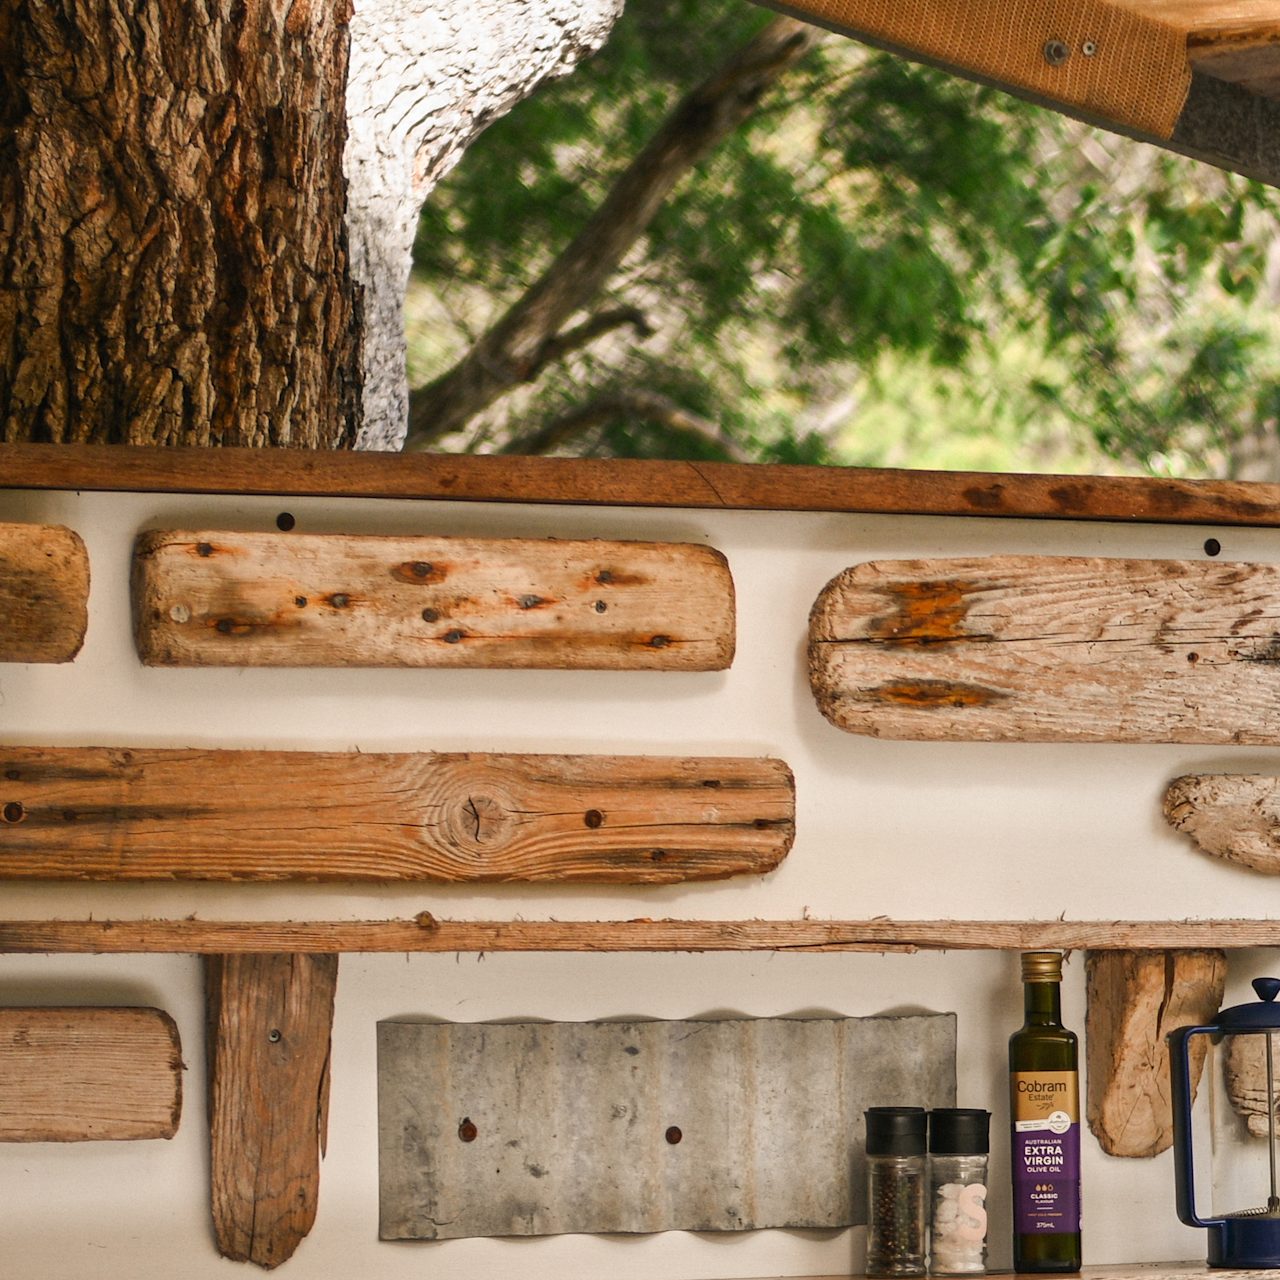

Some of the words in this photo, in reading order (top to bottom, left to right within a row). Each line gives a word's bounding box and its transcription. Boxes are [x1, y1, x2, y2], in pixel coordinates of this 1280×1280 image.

[1017, 1080, 1067, 1093] Cobram
[1028, 1094, 1053, 1102] Estate
[1024, 1146, 1063, 1156] EXTRA
[1024, 1156, 1064, 1165] VIRGIN
